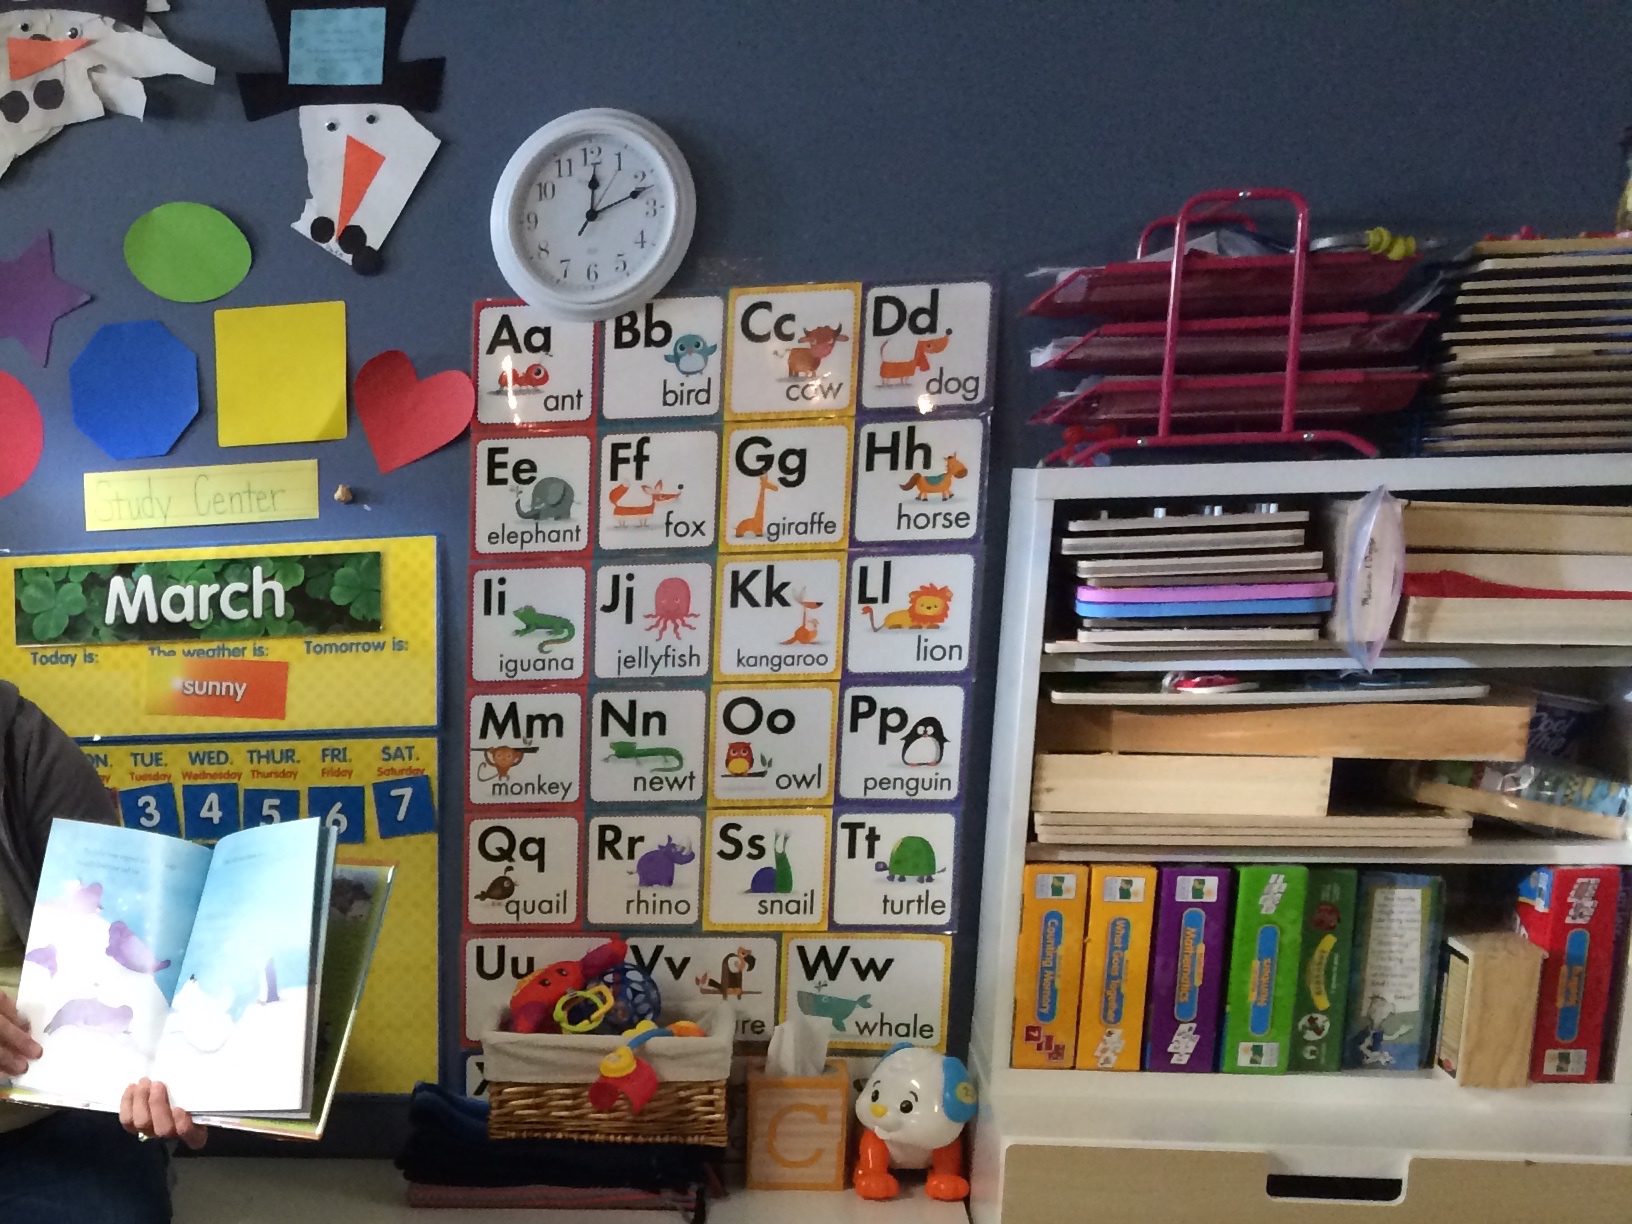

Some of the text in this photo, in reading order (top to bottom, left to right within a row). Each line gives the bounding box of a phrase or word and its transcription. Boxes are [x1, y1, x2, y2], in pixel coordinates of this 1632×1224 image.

[554, 158, 574, 178] 11
[581, 145, 603, 167] 12
[614, 151, 623, 171] 1
[536, 181, 556, 202] 10
[633, 170, 648, 192] 2
[526, 211, 539, 231] 9
[645, 198, 657, 217] 3
[537, 239, 550, 260] 8
[633, 229, 647, 249] 4
[560, 258, 571, 279] 7
[586, 264, 599, 283] 6
[614, 253, 627, 272] 5
[613, 303, 672, 350] Bb
[740, 301, 796, 345] Cc
[873, 289, 939, 337] Dd
[486, 314, 552, 354] Aa
[662, 380, 711, 407] bird
[785, 379, 844, 402] cow
[926, 368, 980, 401] dog
[543, 390, 584, 411] ant
[610, 436, 651, 482] Ff
[735, 436, 808, 488] Gg
[865, 425, 932, 473] Hh
[486, 446, 538, 486] Ee
[94, 474, 286, 524] Study Center
[664, 512, 706, 538] fox
[766, 517, 837, 540] giraffe
[897, 504, 971, 531] horse
[487, 523, 582, 549] elephant
[104, 566, 285, 625] March
[483, 574, 507, 616] Ii
[730, 565, 793, 609] Kk
[857, 560, 892, 605] Ll
[600, 573, 635, 624] Jj
[30, 648, 99, 667] Today is:
[148, 642, 269, 659] The weather is:
[304, 636, 409, 655] Tomorrow is:
[916, 635, 963, 662] lion
[499, 654, 574, 678] iguana
[617, 648, 701, 676] jellyfish
[736, 650, 829, 673] kangaroo
[182, 679, 248, 702] sunny
[479, 702, 564, 740] Mm
[600, 700, 667, 738] Nn
[722, 696, 796, 736] Oo
[848, 695, 909, 745] Pp
[129, 751, 168, 768] TUE.
[188, 750, 234, 767] WED.
[246, 748, 301, 765] THUR.
[321, 746, 352, 763] FRI.
[381, 745, 420, 762] SAT.
[129, 766, 426, 783] Tuesday Wednesday Thursday Friday Saturday
[633, 770, 696, 793] newt
[775, 764, 822, 790] owl
[863, 772, 952, 796] penguin
[491, 777, 573, 800] monkey
[137, 795, 161, 828] 3
[199, 792, 223, 825] 4
[260, 798, 281, 826] 5
[389, 786, 413, 822] 7
[325, 801, 348, 835] 6
[478, 825, 546, 872] Qq
[598, 824, 645, 861] Rr
[716, 822, 766, 861] Ss
[840, 822, 881, 861] Tt
[505, 891, 568, 920] quail
[625, 890, 691, 916] rhino
[757, 891, 815, 916] snail
[881, 890, 946, 916] turtle
[475, 945, 534, 980] Uu
[630, 944, 691, 980] Vv
[796, 945, 894, 982] Ww
[1178, 926, 1197, 1004] Mathematics
[855, 1012, 934, 1039] whale
[768, 1103, 830, 1168] C
